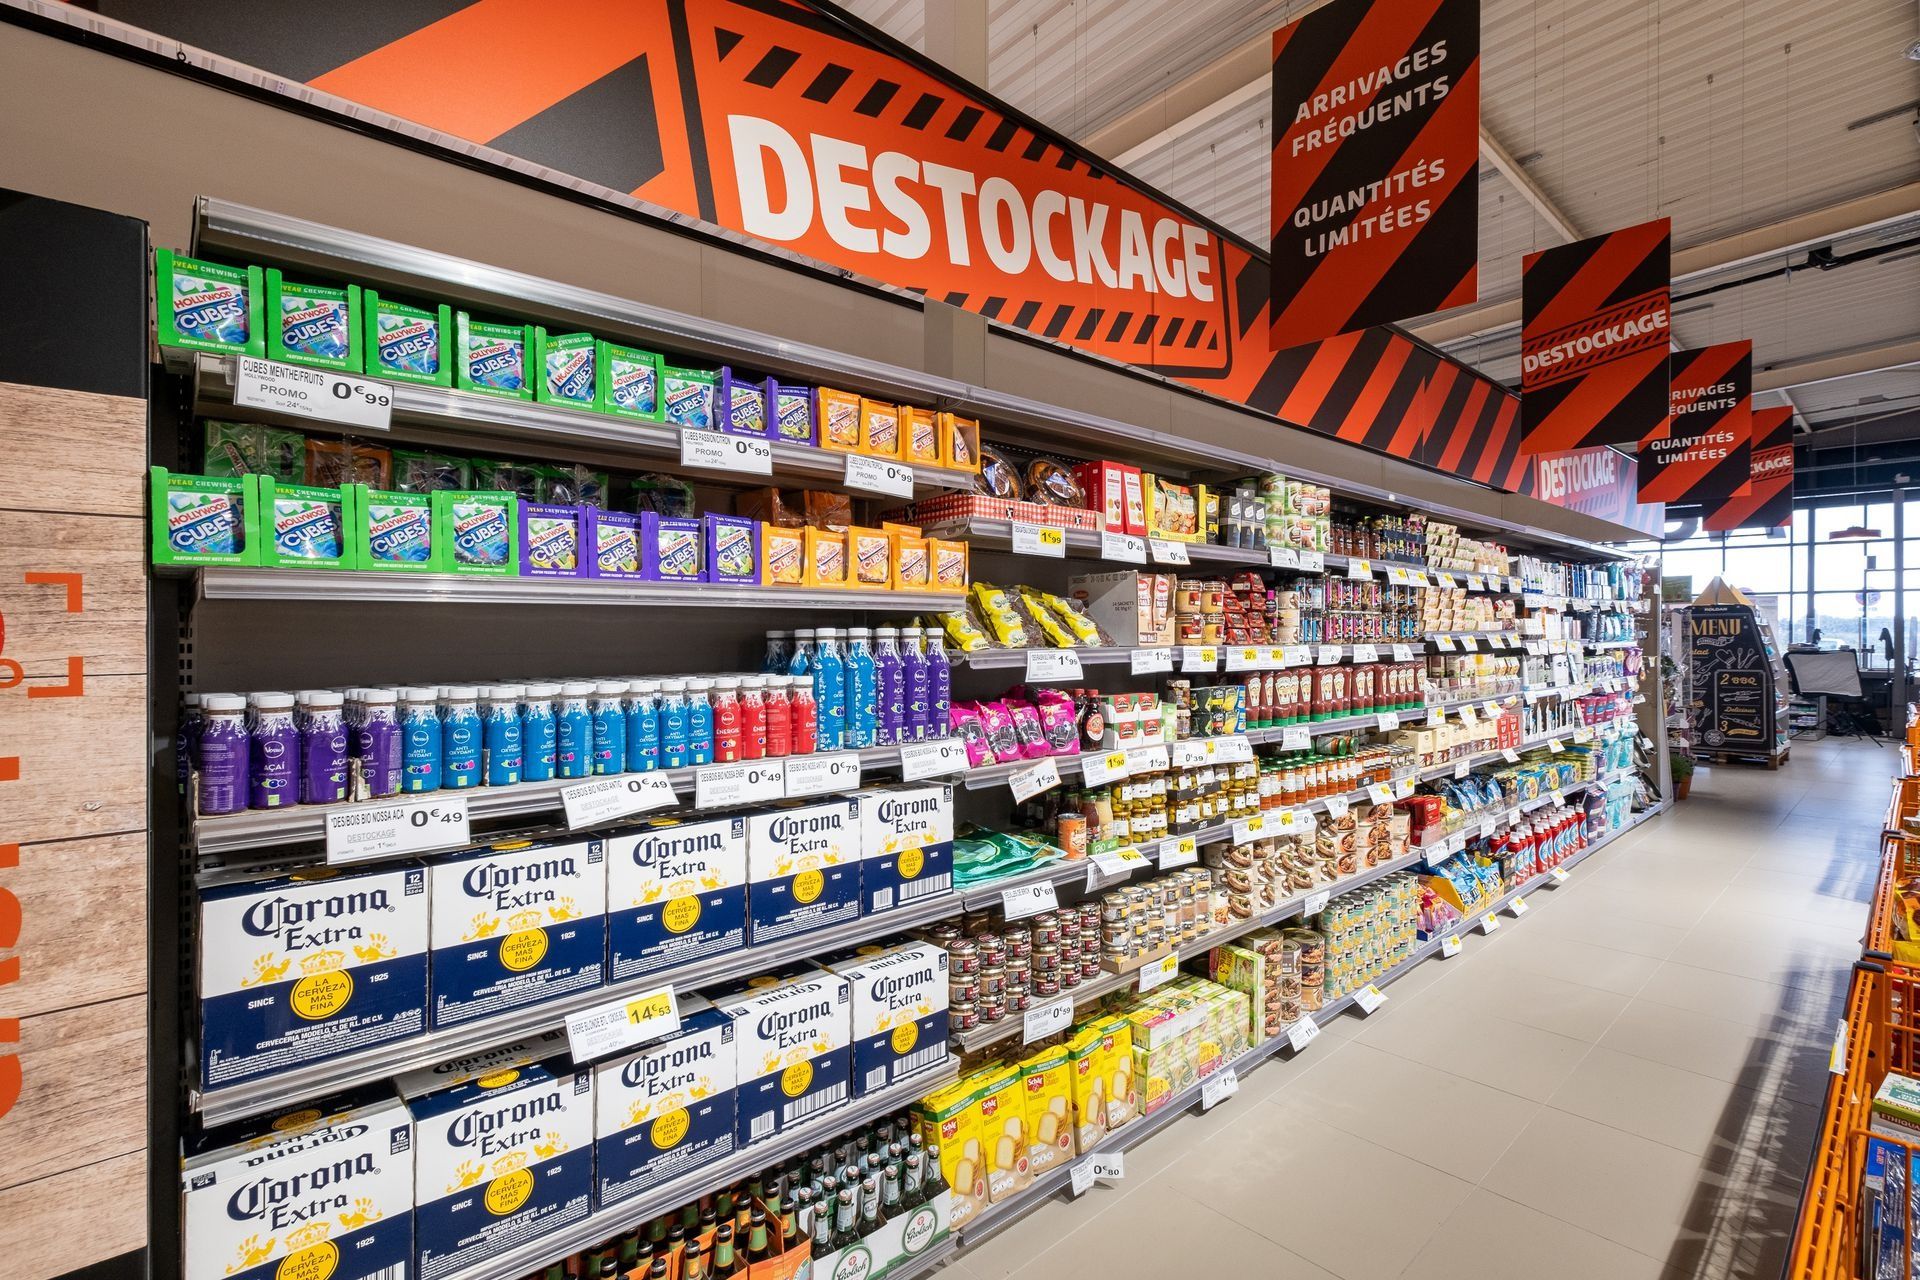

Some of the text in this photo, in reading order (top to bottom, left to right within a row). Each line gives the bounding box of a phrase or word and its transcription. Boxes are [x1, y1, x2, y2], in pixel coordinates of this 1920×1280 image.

[1295, 39, 1447, 125] ARRIVAGES
[1292, 75, 1449, 158] FRÉQUENTS
[1294, 158, 1446, 229] QUANTITÉS
[727, 114, 1214, 302] DESTOCKAGE
[1305, 199, 1431, 257] LIMITÉES
[174, 290, 231, 310] HOLLYWOOD
[180, 302, 244, 329] CUBES
[283, 307, 329, 328] HOLLYWOOD
[283, 317, 341, 345] CUBES
[379, 325, 425, 344] HOLLYWOOD
[383, 335, 435, 361] CUBES
[1523, 309, 1669, 374] DESTOCKAGE
[243, 360, 324, 385] CUBES MENTHE/FRUITS
[470, 354, 516, 377] CUBES
[260, 384, 308, 400] PROMO
[332, 382, 389, 407] 0€99
[1670, 382, 1736, 402] RIVAGES
[672, 394, 704, 416] CUBES
[736, 441, 769, 456] 0€99
[1651, 430, 1735, 452] QUANTITÉS
[695, 448, 723, 457] PROMO
[1657, 448, 1727, 464] LIMITÉES
[856, 471, 878, 480] PROMO
[887, 468, 912, 483] 0€99
[1541, 450, 1615, 500] DESTOCKAGE
[169, 502, 228, 526] HOLLYWOOD
[278, 509, 327, 530] HOLLYWOOD
[176, 511, 239, 546] CUBES
[370, 513, 417, 534] HOLLYWOOD
[284, 518, 337, 547] CUBES
[374, 522, 426, 552] CUBES
[461, 520, 505, 548] CUBES
[1042, 532, 1062, 544] 1€99
[1692, 618, 1741, 636] MENU
[1720, 673, 1730, 685] 2
[1720, 720, 1728, 732] 3
[941, 746, 964, 758] 0€79
[264, 761, 285, 771] AÇAÍ
[830, 762, 858, 774] 0€79
[1150, 758, 1167, 768] 1€29
[628, 778, 667, 792] 0€49
[749, 770, 781, 784] 0€49
[1035, 771, 1055, 788] 1€29
[361, 811, 371, 824] BIO
[372, 810, 391, 823] NOSSA
[392, 808, 404, 820] ACA
[410, 808, 462, 827] 0€49
[878, 797, 937, 825] Corona
[769, 814, 841, 845] Corona
[895, 818, 927, 834] Extra
[347, 829, 396, 843] DESTOCKAGE
[633, 833, 722, 868] Corona
[789, 838, 828, 855] Extra
[463, 857, 576, 899] Corona
[659, 861, 706, 879] Extra
[409, 874, 420, 883] 12
[796, 878, 820, 888] CERVEZA
[495, 889, 555, 911] Extra
[1033, 887, 1053, 897] 0€69
[242, 888, 389, 938] Corona
[637, 914, 653, 923] SINCE
[667, 905, 696, 917] CERVEZA
[674, 919, 689, 927] FINA
[285, 925, 362, 952] Extra
[561, 931, 575, 940] 1925
[505, 939, 543, 952] CERVEZA
[515, 948, 533, 956] MAS
[467, 950, 488, 961] SINCE
[515, 956, 533, 964] FINA
[315, 978, 328, 987] LA
[369, 972, 388, 983] 1925
[871, 968, 932, 1003] Corona
[298, 982, 346, 998] CERVEZA
[248, 997, 274, 1009] SINCE
[310, 1001, 334, 1012] FINA
[311, 993, 334, 1004] MAS
[889, 992, 921, 1011] Extra
[632, 1004, 671, 1024] 14€53
[1053, 1006, 1071, 1019] 0€59
[757, 1001, 830, 1041] Corona
[256, 1035, 300, 1050] CERVECERIA
[362, 1017, 371, 1025] DE
[778, 1027, 817, 1050] Extra
[621, 1041, 712, 1088] Corona
[578, 1075, 587, 1083] 12
[785, 1069, 810, 1083] CERVEZA
[791, 1077, 804, 1085] MAS
[648, 1072, 695, 1097] Extra
[791, 1083, 804, 1091] FINA
[447, 1092, 563, 1147] Corona
[655, 1117, 686, 1133] CERVEZA
[666, 1115, 675, 1123] LA
[625, 1134, 642, 1145] SINCE
[662, 1133, 678, 1143] FINA
[663, 1127, 678, 1136] MAS
[481, 1127, 541, 1158] Extra
[547, 1166, 562, 1177] 1925
[1094, 1165, 1119, 1175] 0€80
[227, 1153, 375, 1221] Corona
[490, 1178, 528, 1198] CERVEZA
[504, 1177, 515, 1186] LA
[500, 1190, 519, 1201] MAS
[500, 1196, 519, 1207] FINA
[270, 1193, 348, 1231] Extra
[451, 1199, 472, 1213] SINCE
[356, 1236, 374, 1249] 1925
[283, 1253, 332, 1276] CERVEZA
[301, 1252, 314, 1262] LA
[296, 1265, 319, 1279] MAS
